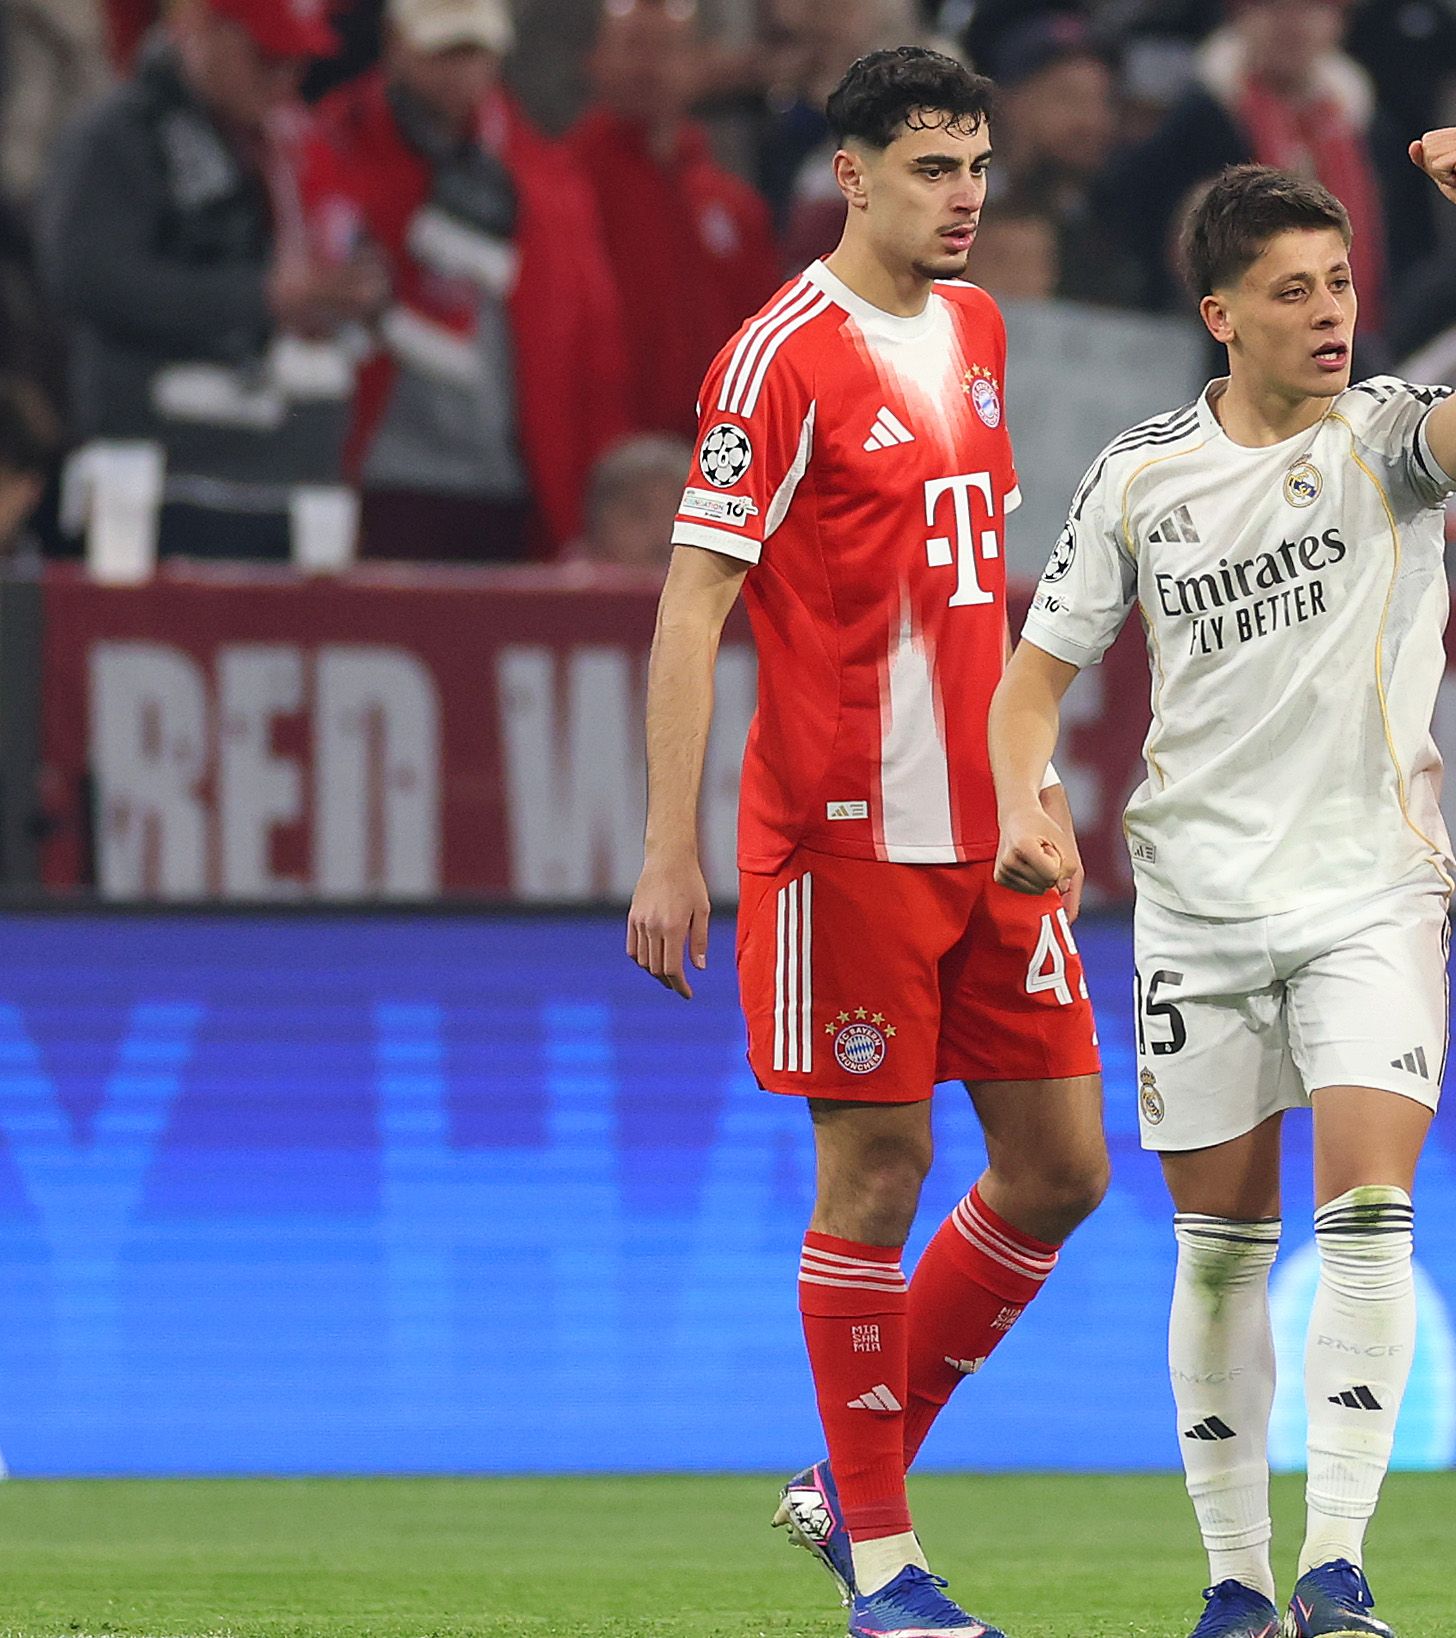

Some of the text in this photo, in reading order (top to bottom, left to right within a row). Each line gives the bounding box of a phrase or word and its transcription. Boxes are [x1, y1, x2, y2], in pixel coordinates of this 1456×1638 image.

[717, 443, 730, 468] 6
[924, 471, 994, 608] T
[1155, 528, 1346, 617] Emirates
[1190, 580, 1327, 655] FLY BETTER
[88, 642, 442, 896] RED
[849, 1027, 882, 1047] BAYERN
[852, 1325, 879, 1335] MIA
[852, 1334, 879, 1343] SAN
[853, 1343, 881, 1352] MIA
